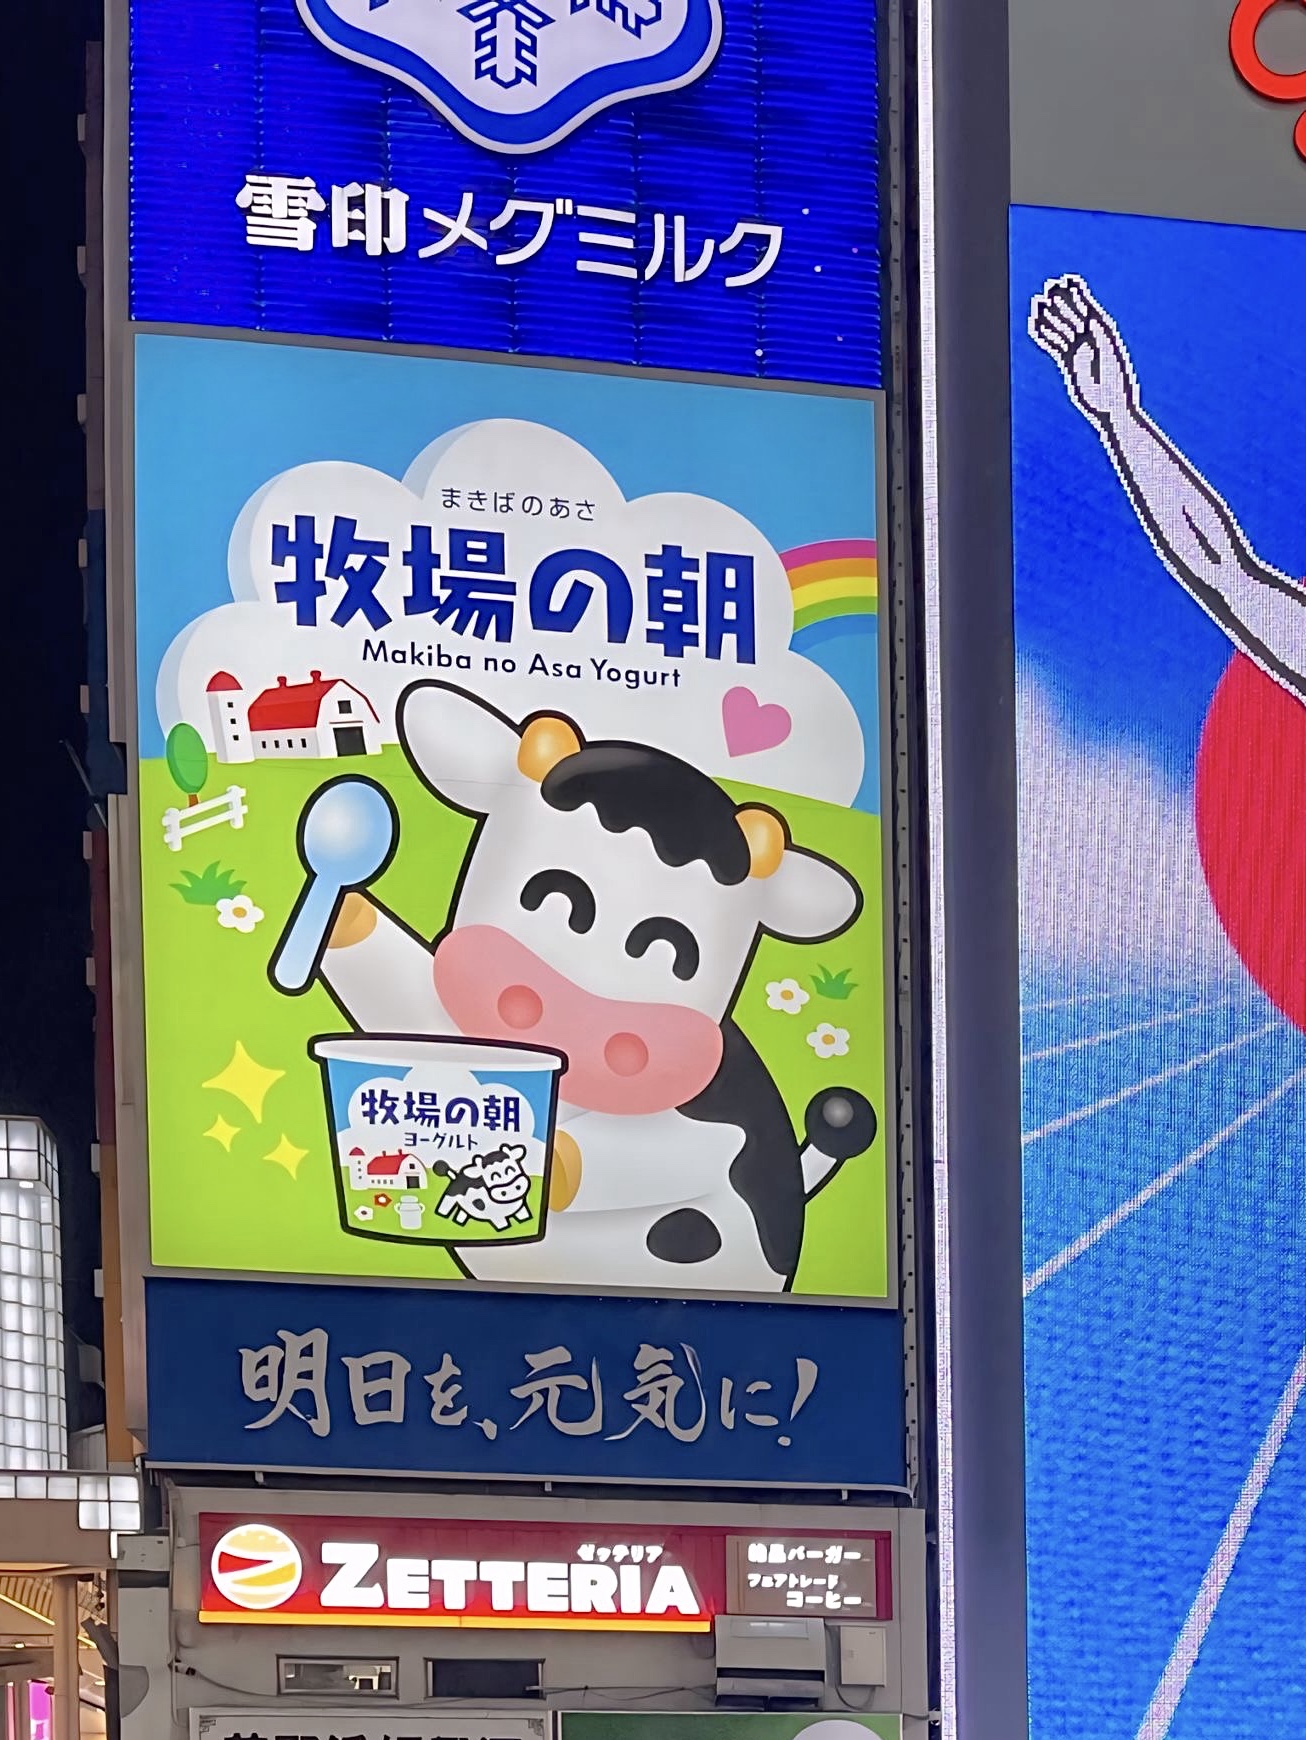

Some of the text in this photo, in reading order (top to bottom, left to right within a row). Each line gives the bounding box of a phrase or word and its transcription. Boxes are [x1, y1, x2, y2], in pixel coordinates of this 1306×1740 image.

[235, 173, 785, 288] 雪印メグミルク
[441, 488, 596, 522] まきばのあさ
[270, 514, 757, 665] 牧場の朝
[362, 639, 681, 689] Makiba no Asa Yogurt
[361, 1089, 520, 1133] 牧場の朝
[404, 1132, 478, 1151] ヨーグルト
[320, 1542, 700, 1615] ZETTERIA
[787, 1591, 862, 1609] コーヒー
